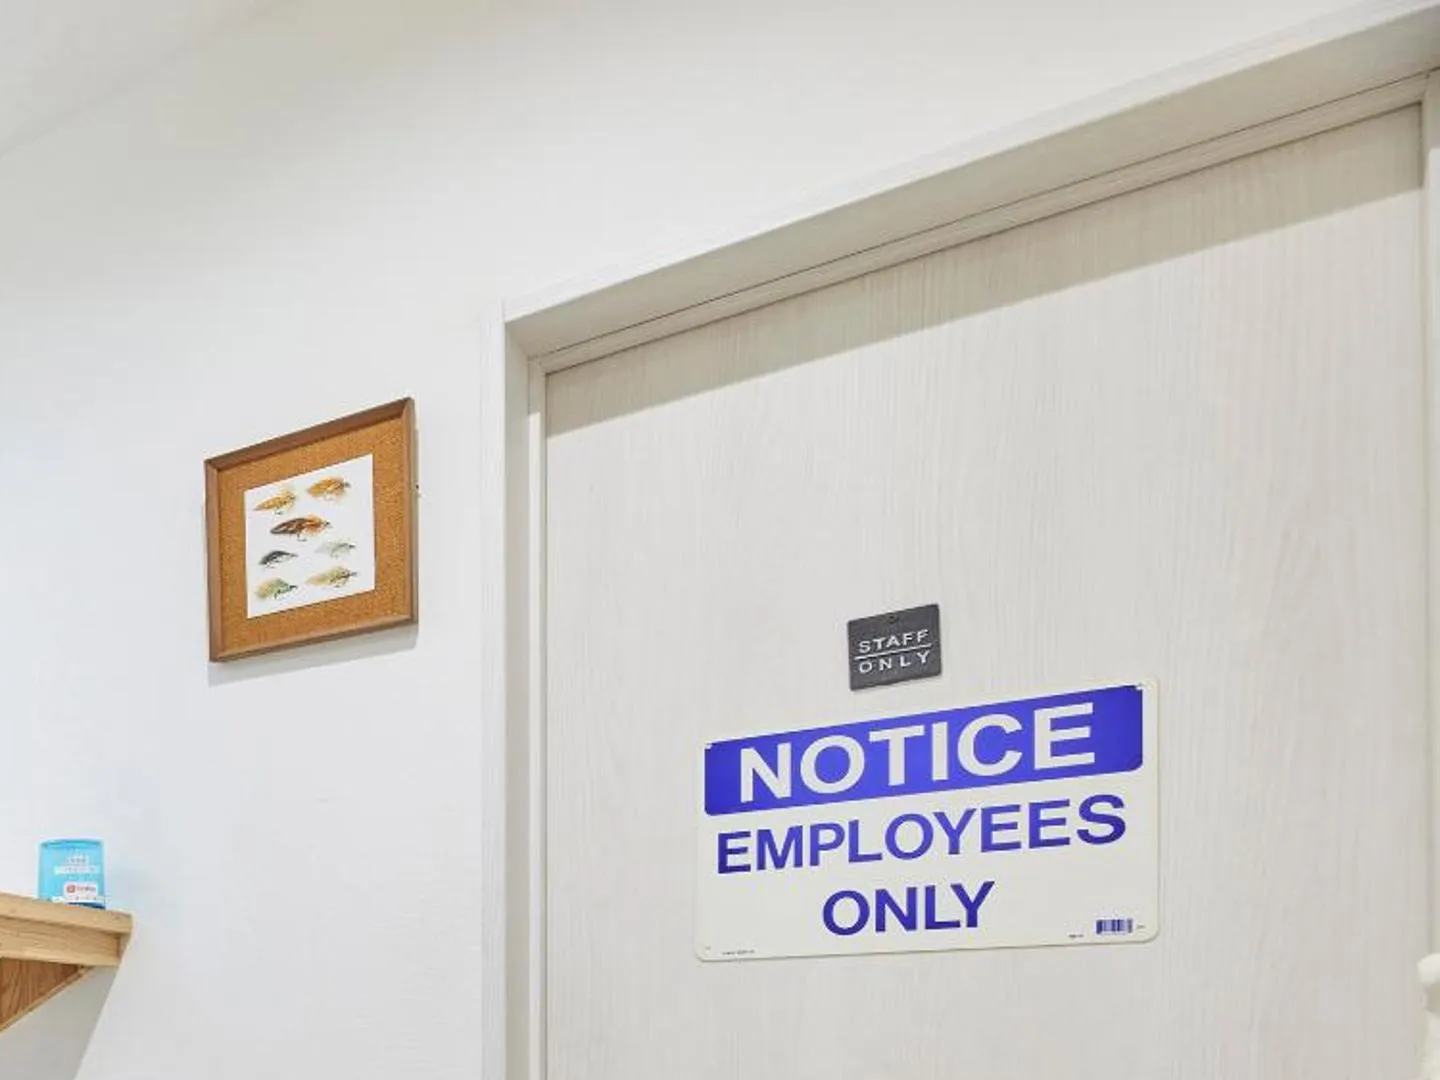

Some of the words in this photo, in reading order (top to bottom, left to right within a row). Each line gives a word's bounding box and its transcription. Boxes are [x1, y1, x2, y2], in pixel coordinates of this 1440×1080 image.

[858, 628, 930, 655] STAFF
[858, 650, 931, 674] ONLY
[740, 702, 1096, 804] NOTICE
[717, 794, 1127, 875] EMPLOYEES
[822, 881, 996, 937] ONLY
